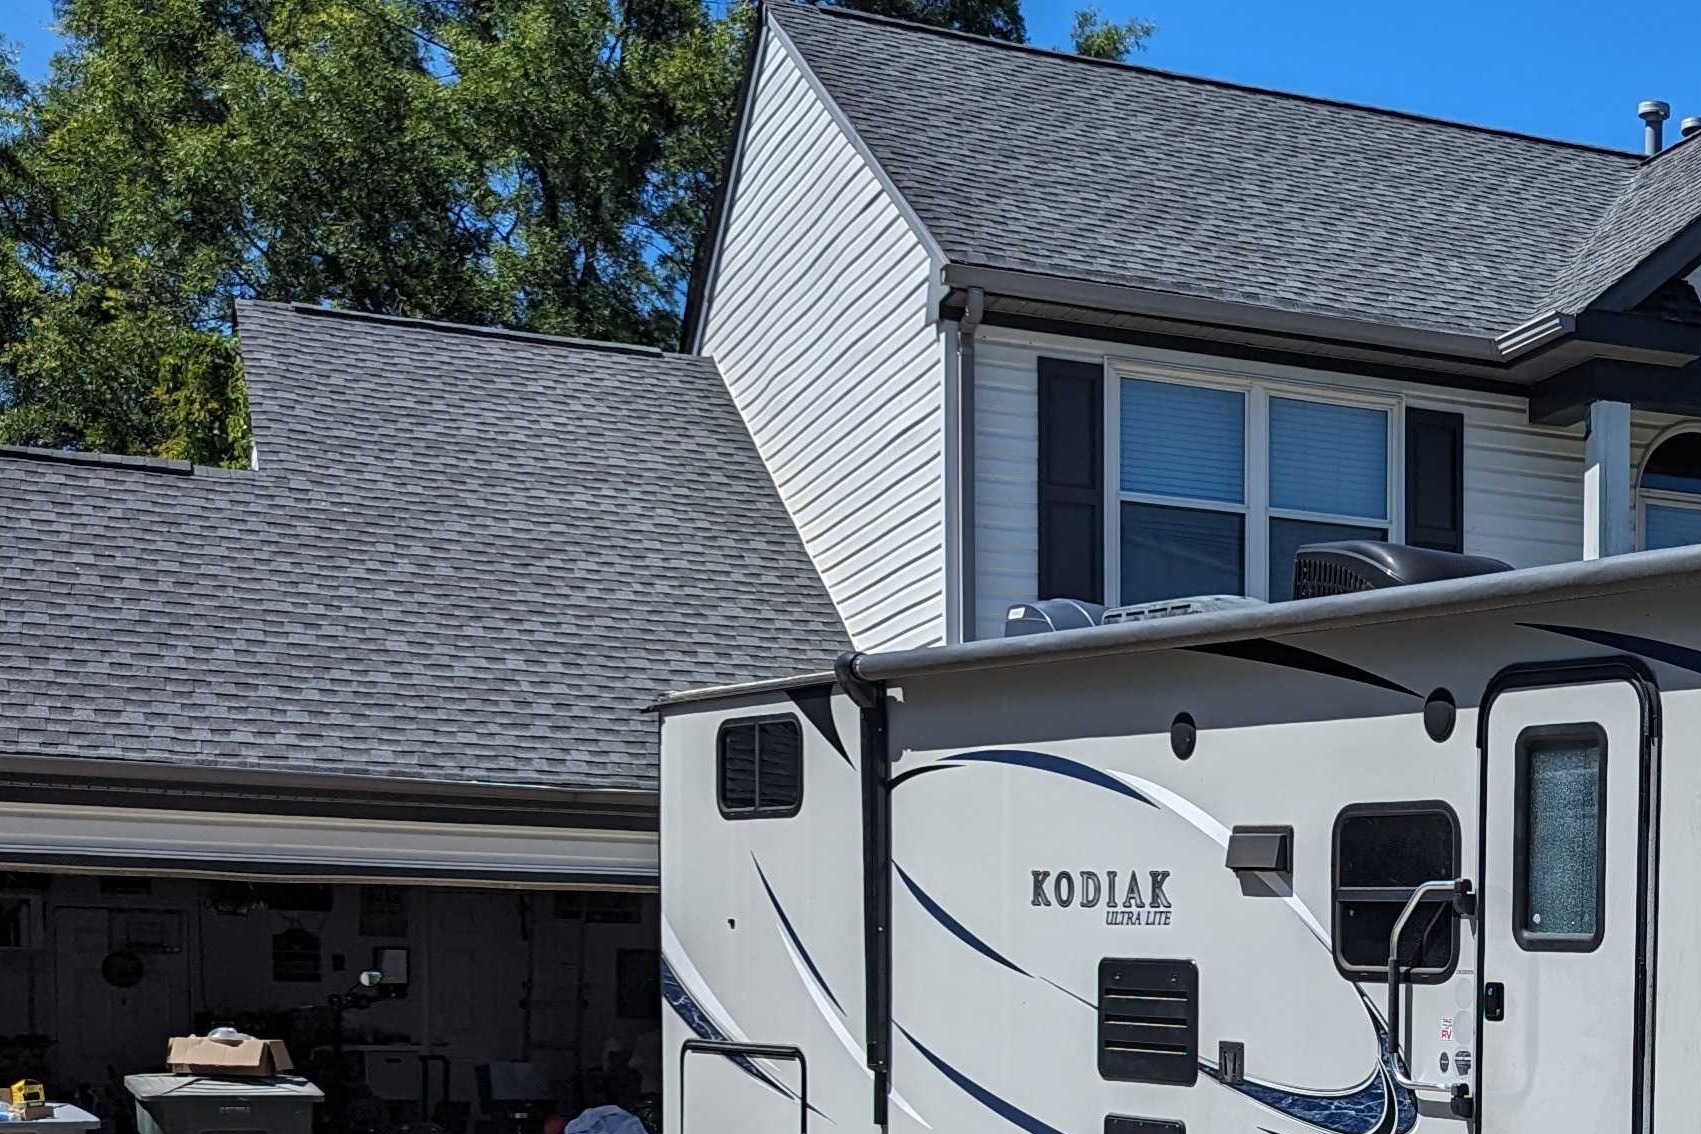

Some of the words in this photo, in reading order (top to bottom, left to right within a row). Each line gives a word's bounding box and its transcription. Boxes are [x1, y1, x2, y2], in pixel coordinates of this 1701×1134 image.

[1031, 870, 1172, 908] KODIAK
[1106, 910, 1141, 925] ULTRA
[1145, 910, 1171, 925] LITE
